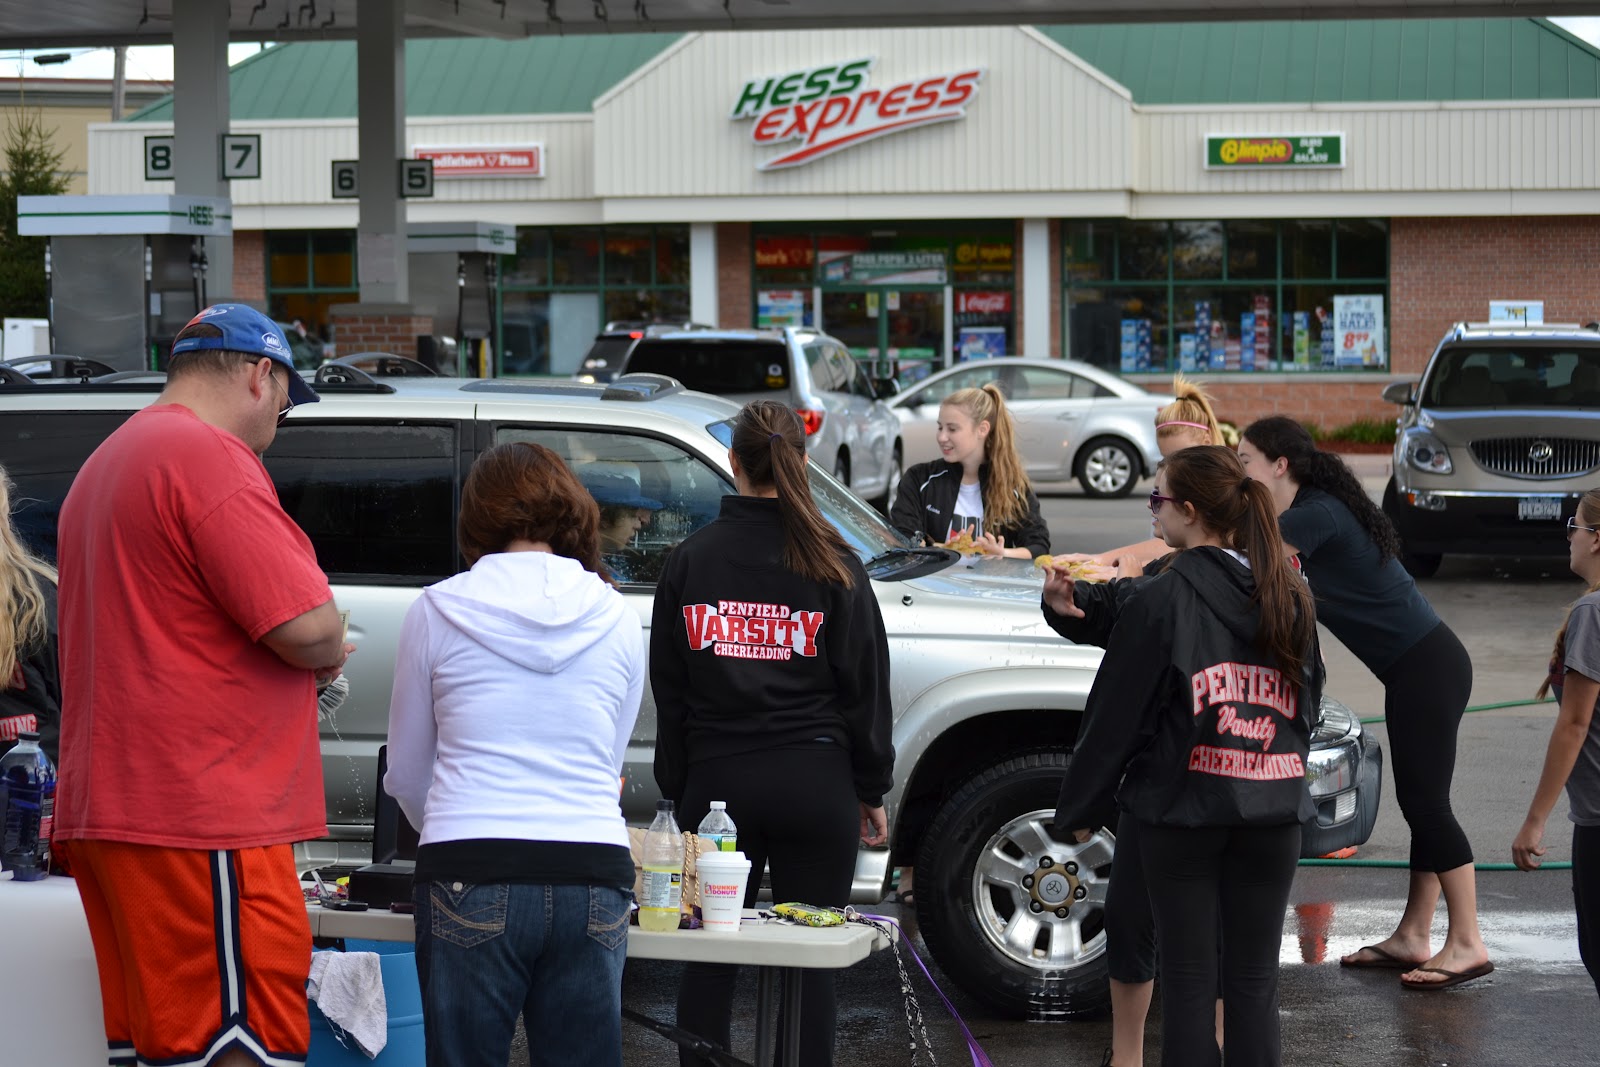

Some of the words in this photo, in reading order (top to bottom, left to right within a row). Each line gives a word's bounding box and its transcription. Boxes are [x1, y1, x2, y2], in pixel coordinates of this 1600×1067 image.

[733, 59, 872, 116] HESS
[151, 145, 171, 170] 8
[231, 145, 252, 169] 7
[426, 154, 486, 168] odfather's
[1220, 139, 1287, 163] Blimpie
[338, 168, 354, 190] 6
[408, 168, 427, 189] 5
[188, 205, 214, 226] HESS
[718, 600, 790, 619] PENFIELD
[683, 603, 824, 657] VARSITY
[713, 641, 792, 660] CHEERLEADING
[1191, 662, 1298, 720] PENFIELD
[1216, 704, 1276, 751] Varsity
[1188, 745, 1305, 780] CHEERLEADING
